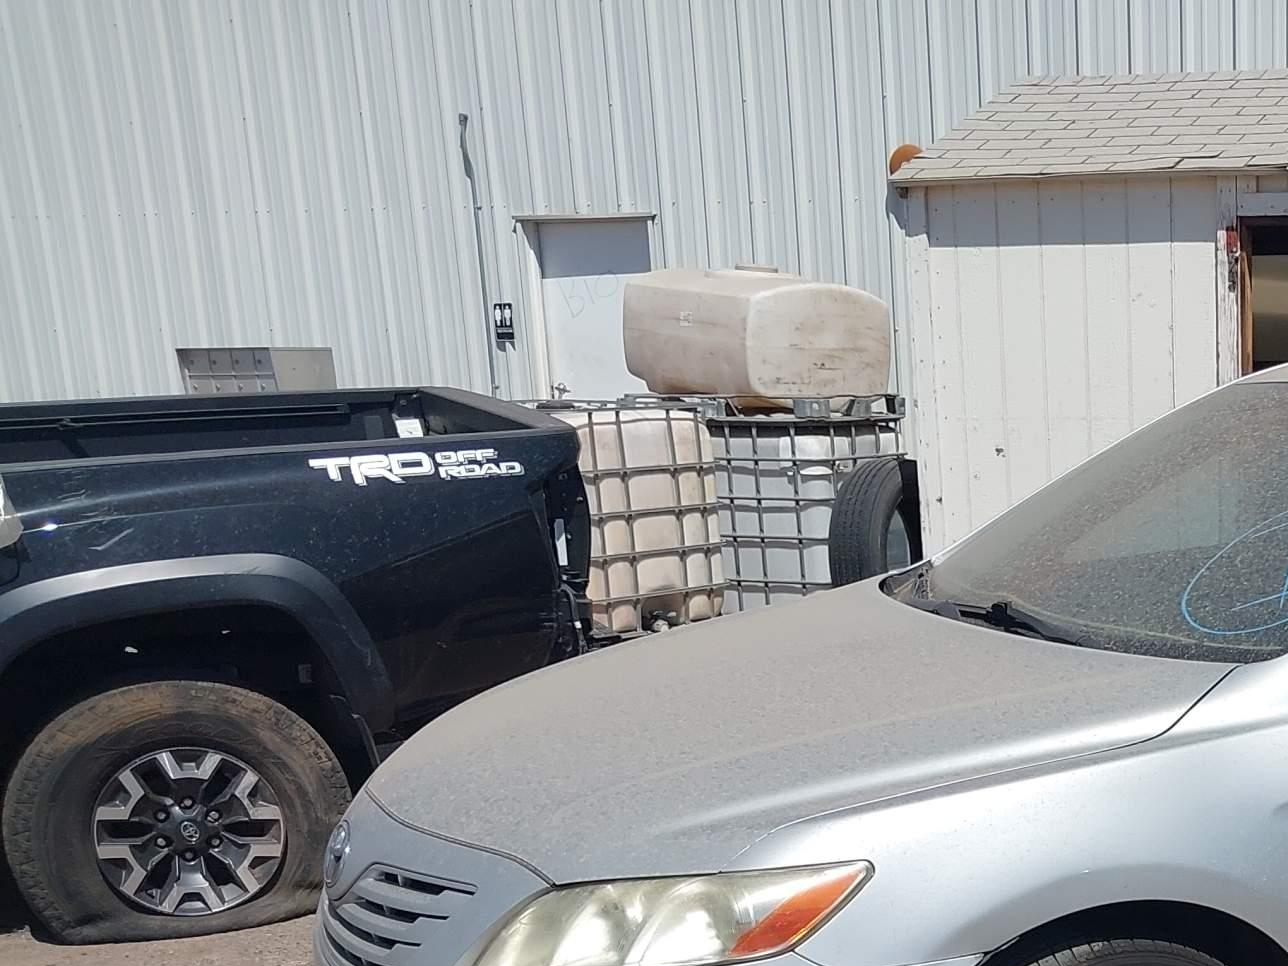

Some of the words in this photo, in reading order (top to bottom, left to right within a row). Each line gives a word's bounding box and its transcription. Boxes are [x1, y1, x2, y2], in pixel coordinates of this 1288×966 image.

[435, 448, 499, 466] OFF
[308, 451, 435, 487] TRD
[438, 461, 525, 481] ROAD
